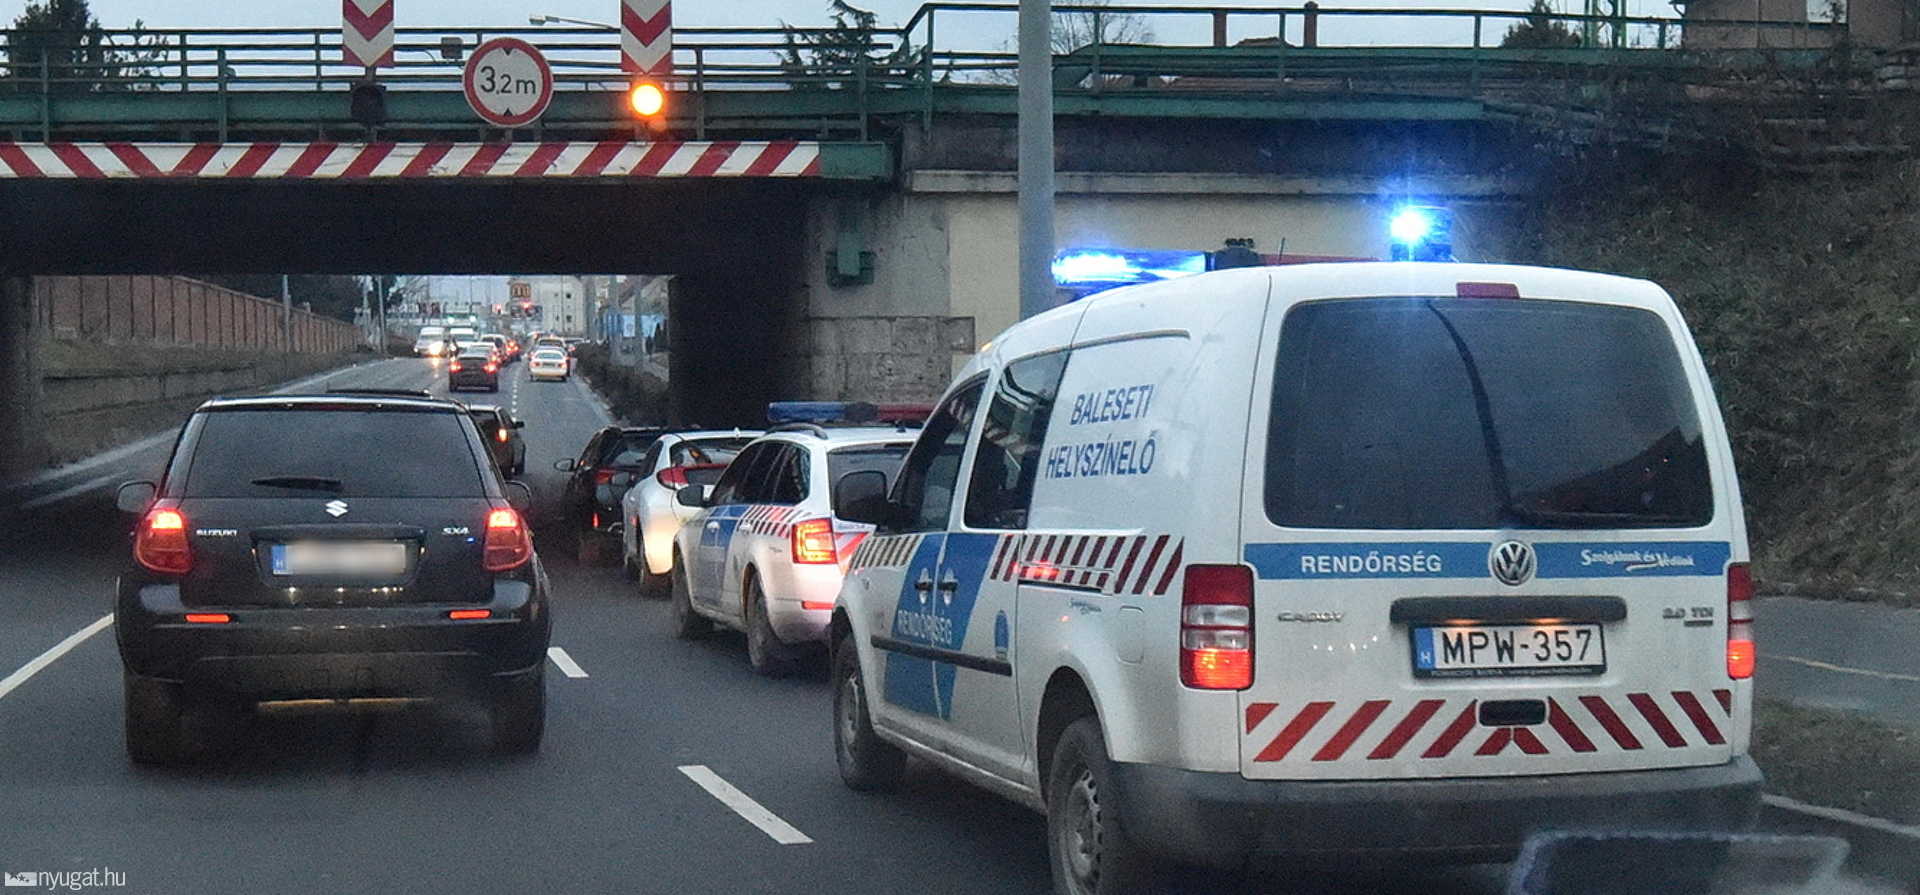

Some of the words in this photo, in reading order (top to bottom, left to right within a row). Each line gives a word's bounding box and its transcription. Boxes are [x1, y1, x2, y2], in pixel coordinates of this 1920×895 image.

[1070, 384, 1155, 425] BALESETI
[1045, 429, 1160, 479] HELYSZÍNELŐ
[441, 527, 470, 536] SX4
[1301, 551, 1442, 573] RENDŐRSÉG
[1442, 630, 1592, 664] MPW-357
